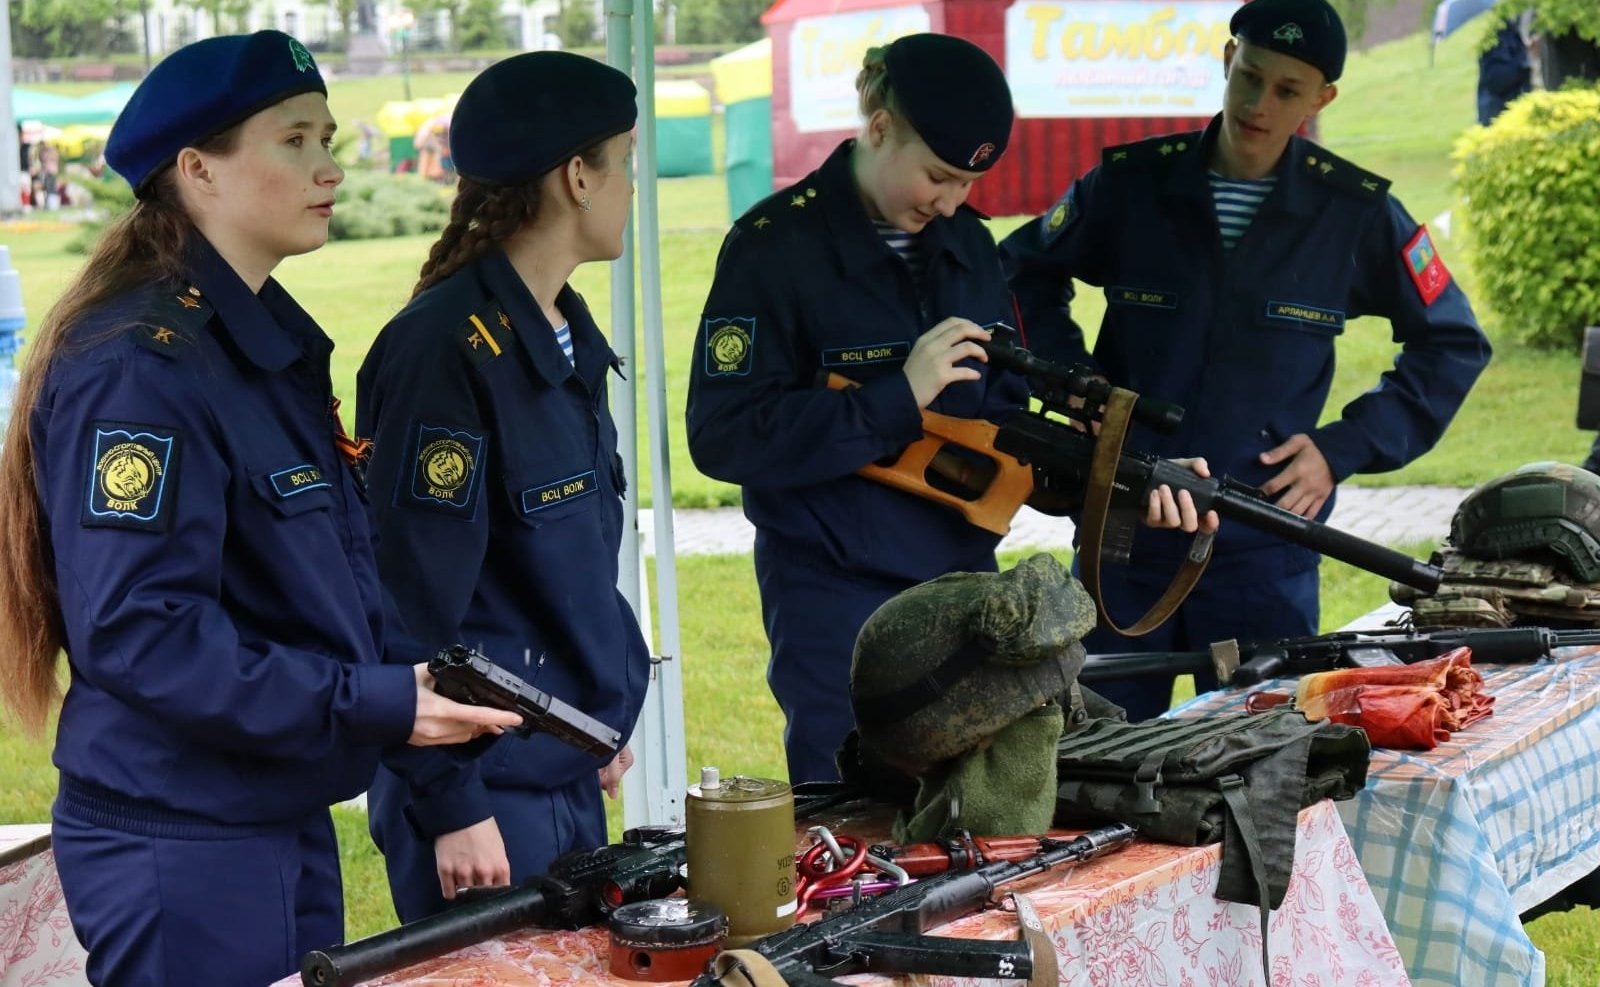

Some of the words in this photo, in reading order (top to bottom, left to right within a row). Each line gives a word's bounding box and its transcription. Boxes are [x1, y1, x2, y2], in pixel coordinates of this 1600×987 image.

[841, 352, 863, 362] ВСЦ
[867, 348, 892, 359] ВОЛК
[290, 471, 313, 486] ВСЦ
[428, 486, 455, 499] ВОЛК
[541, 488, 561, 502] ВСЦ
[563, 480, 585, 496] ВОЛК
[106, 499, 139, 511] ВОЛК
